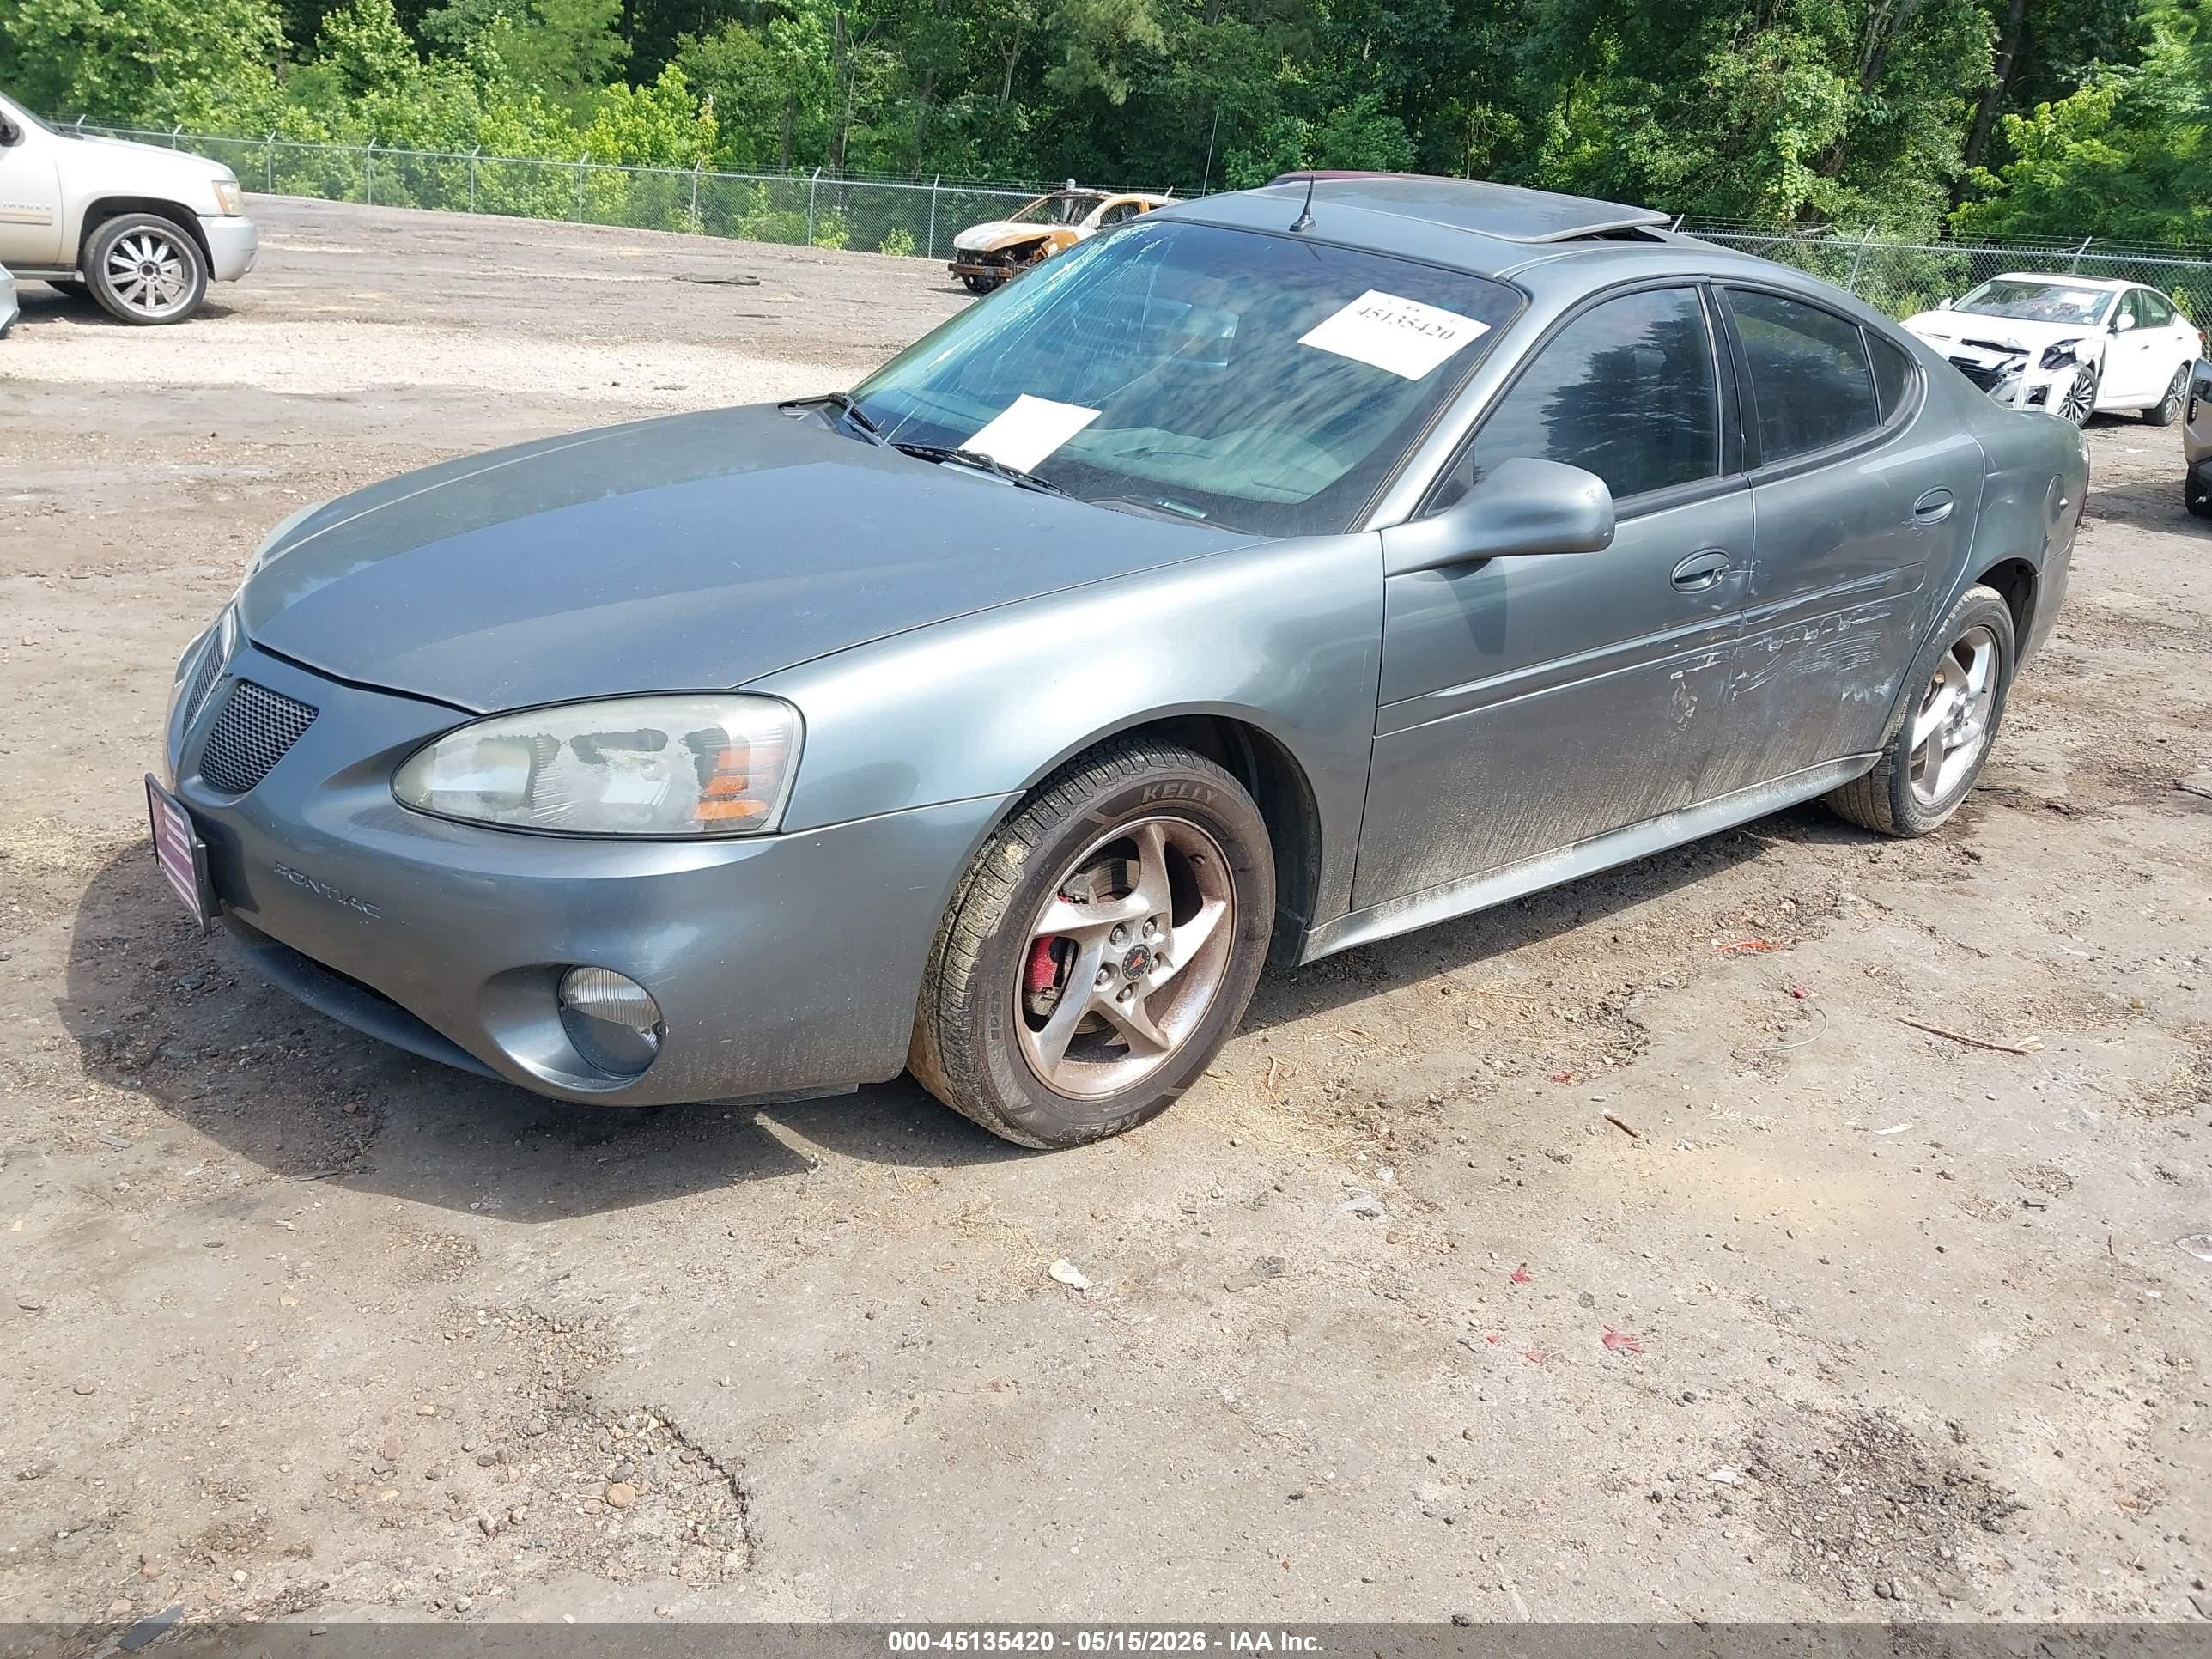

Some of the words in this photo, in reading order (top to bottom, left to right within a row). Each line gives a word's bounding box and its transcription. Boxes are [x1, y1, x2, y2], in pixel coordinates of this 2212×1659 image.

[1357, 307, 1455, 340] 45135420
[1140, 782, 1220, 804] KELLY
[274, 859, 381, 919] PONTIAC
